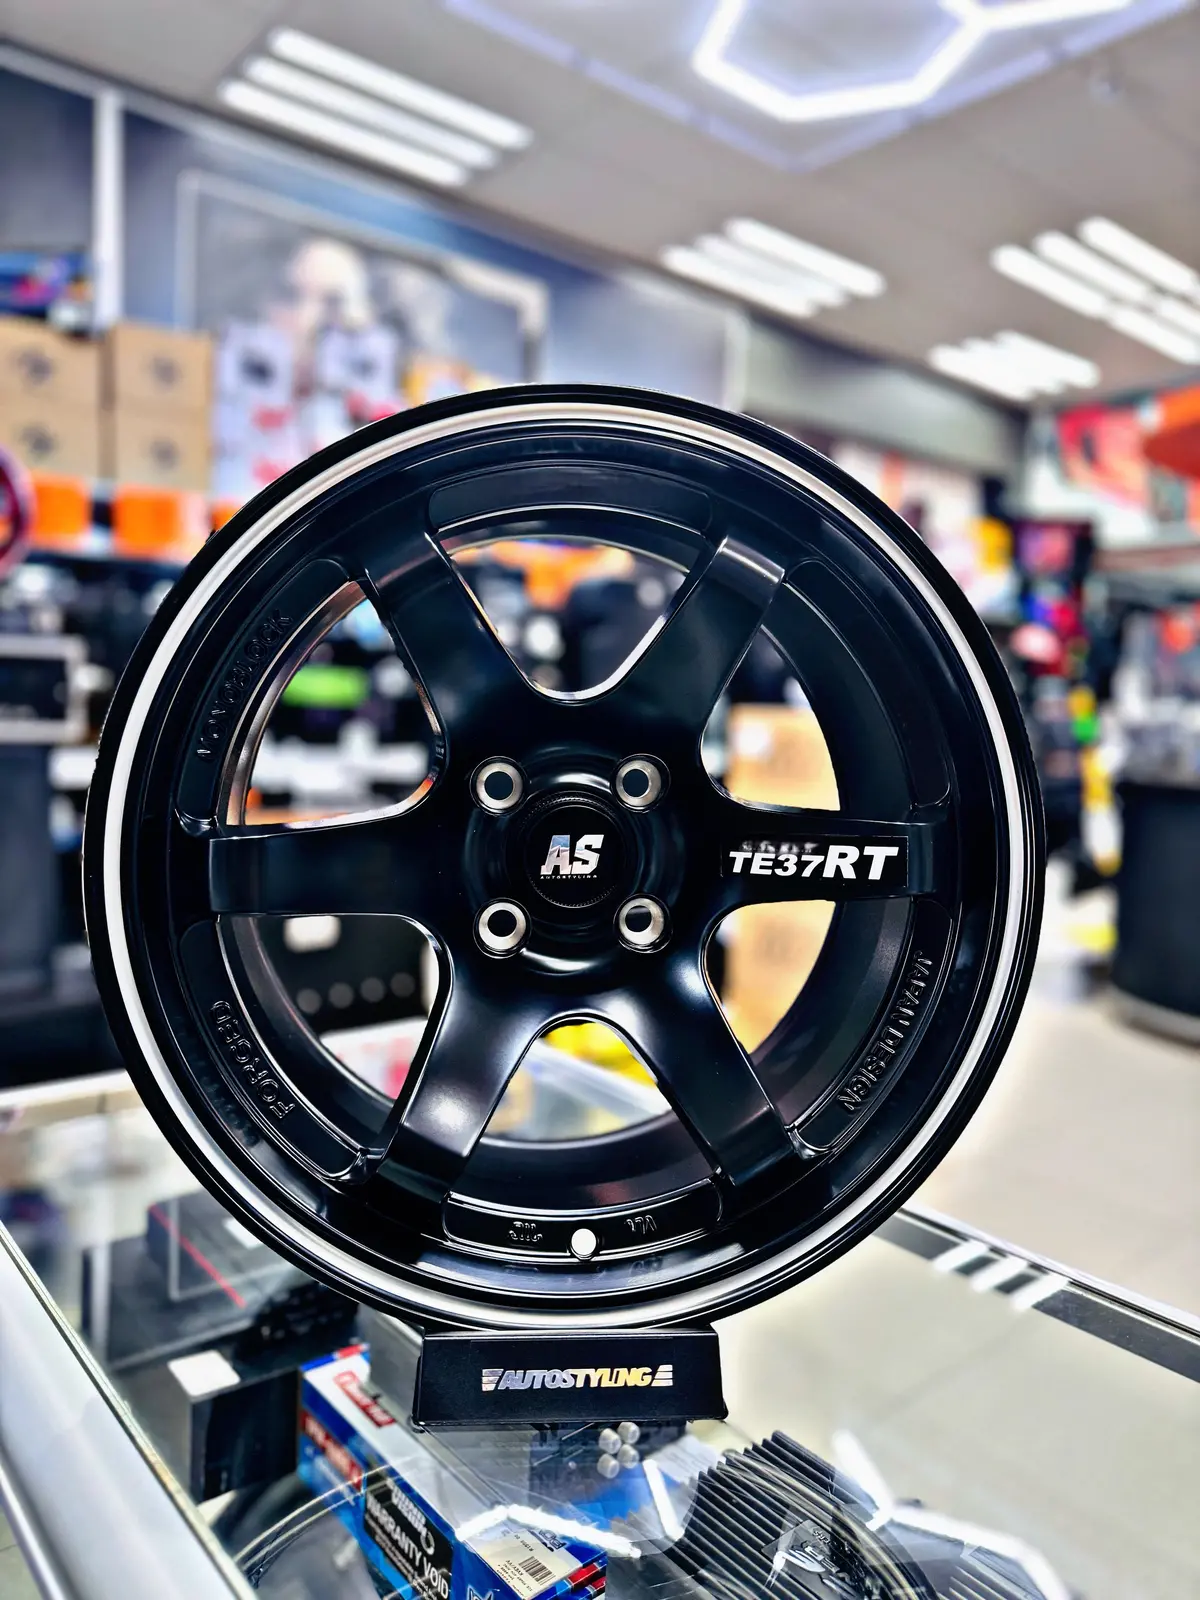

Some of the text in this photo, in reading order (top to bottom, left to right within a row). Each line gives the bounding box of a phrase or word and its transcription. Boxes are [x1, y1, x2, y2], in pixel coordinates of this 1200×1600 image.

[540, 834, 605, 875] AS
[210, 1000, 296, 1119] FORGED
[836, 949, 934, 1111] JAPAN DESIGN
[498, 1367, 653, 1390] AUTOSTYLING
[366, 1494, 423, 1566] WARRANTY
[423, 1557, 449, 1600] VOID
